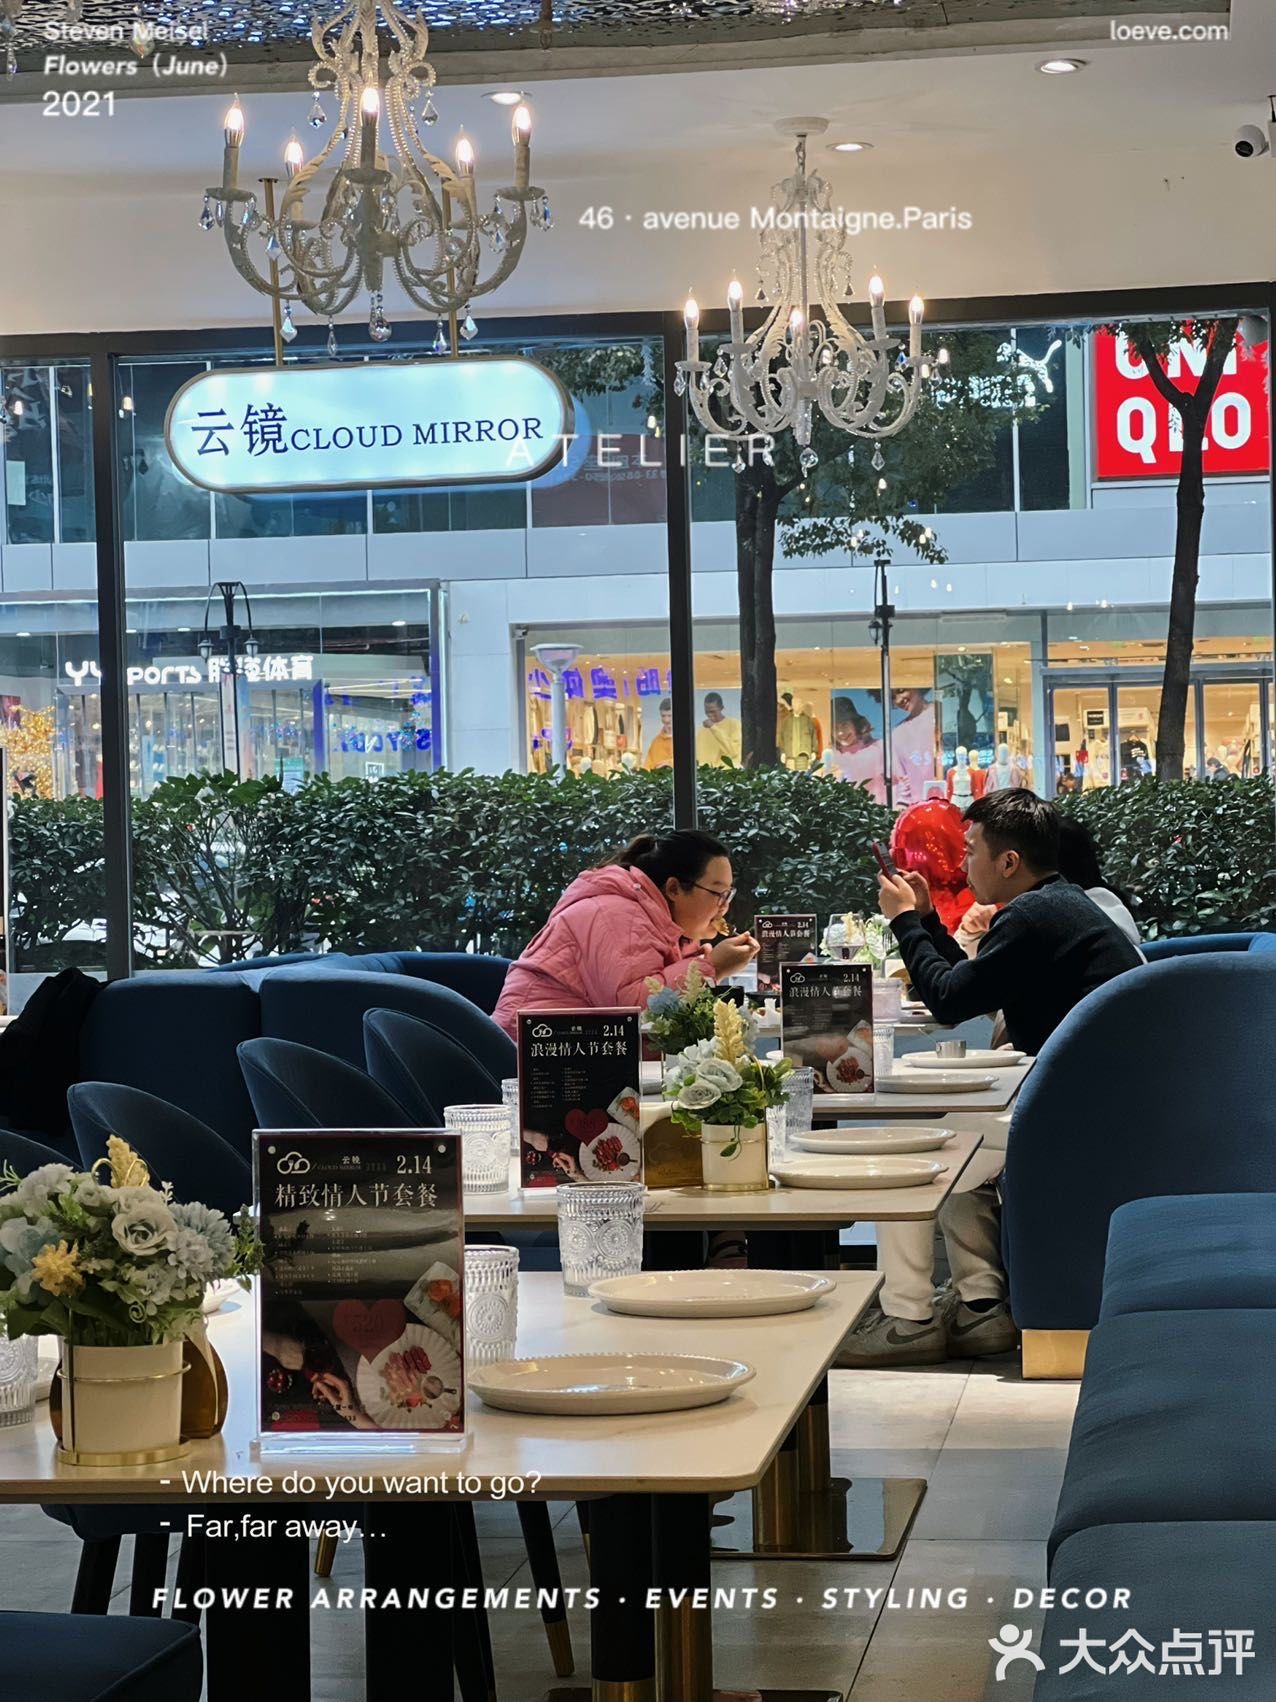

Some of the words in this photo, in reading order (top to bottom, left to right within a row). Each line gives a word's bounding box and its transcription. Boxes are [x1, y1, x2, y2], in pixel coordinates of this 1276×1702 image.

[190, 402, 289, 457] 云镜
[291, 424, 403, 452] CLOUD
[412, 417, 544, 445] MIRROR
[603, 1024, 625, 1037] 2.14
[530, 1041, 628, 1057] 浪漫情人节套餐
[396, 1155, 433, 1174] 2.14
[274, 1183, 439, 1208] 精致情人节套餐
